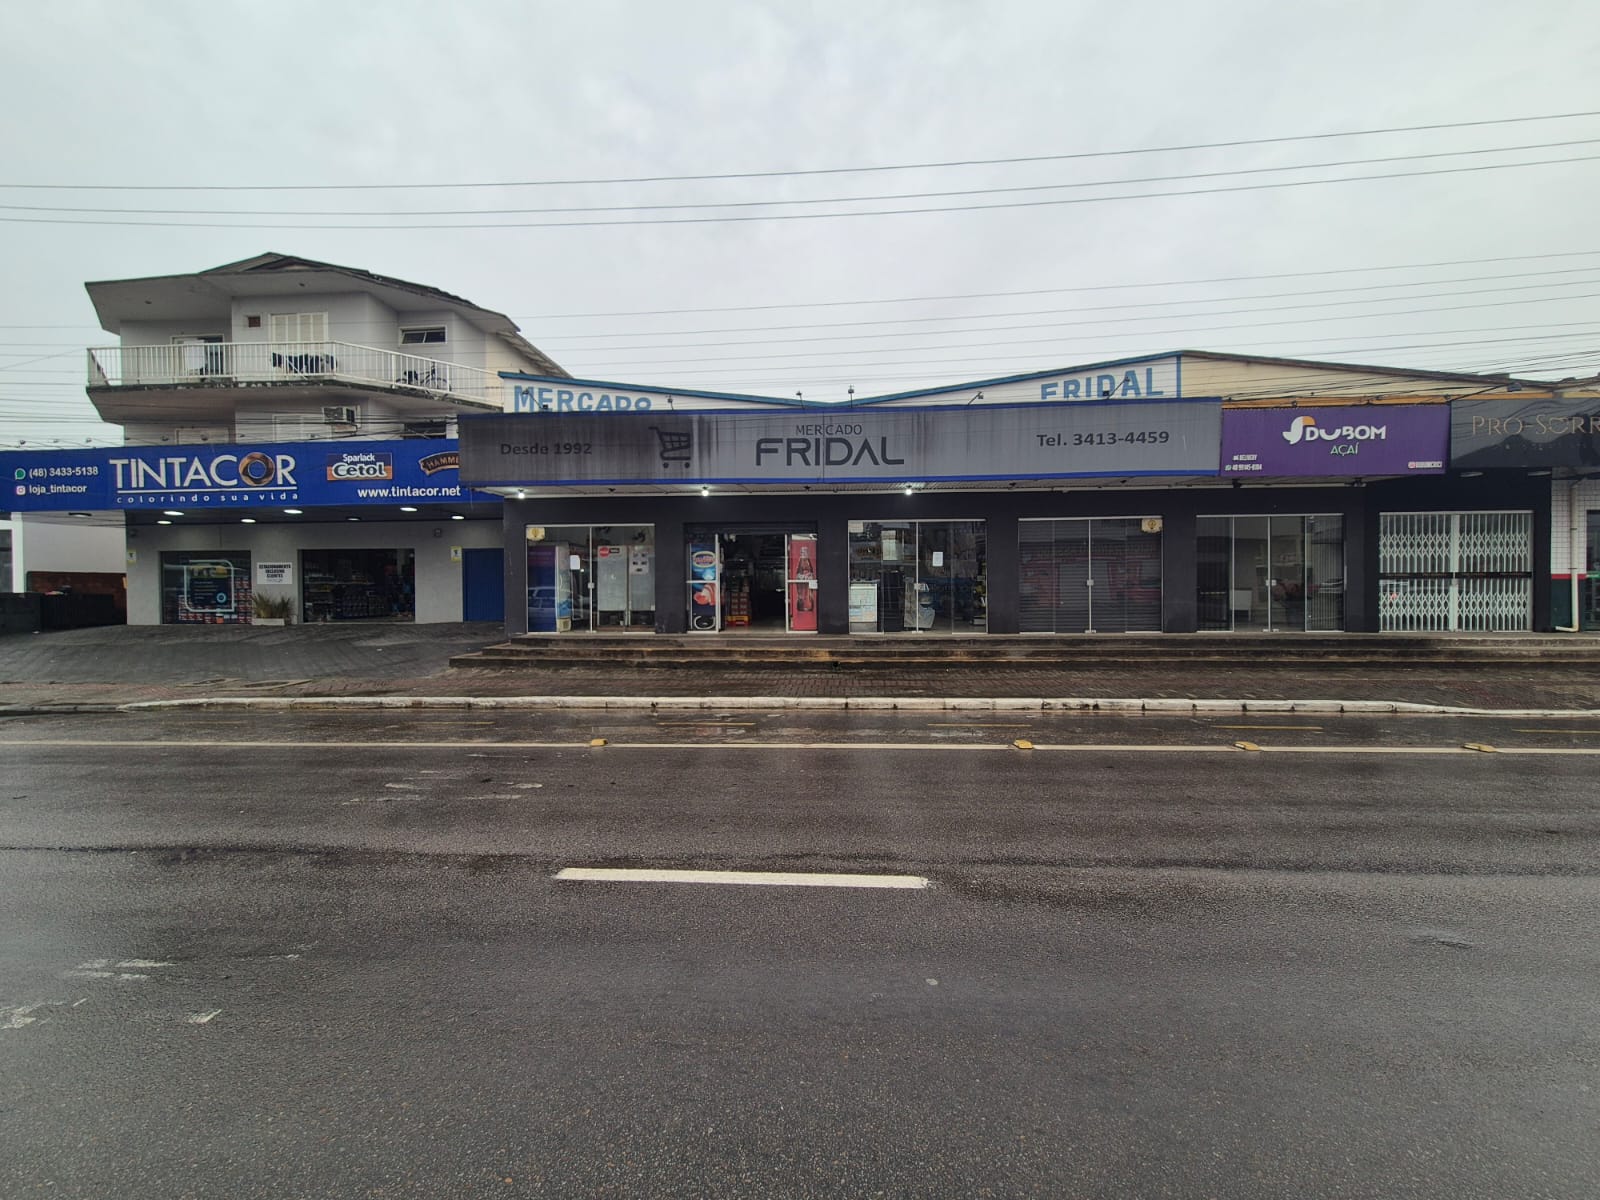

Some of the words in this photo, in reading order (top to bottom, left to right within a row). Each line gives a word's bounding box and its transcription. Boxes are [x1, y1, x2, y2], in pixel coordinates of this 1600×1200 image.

[1040, 367, 1164, 400] FRIDAL
[513, 385, 652, 413] MERCADO
[796, 424, 863, 436] MERCADO
[1305, 425, 1387, 441] DUBOM
[1036, 434, 1068, 447] Tel.
[1072, 431, 1170, 446] 3413-4459
[500, 443, 549, 456] Desde
[553, 443, 593, 455] 1992
[755, 436, 905, 466] FRIDAL
[1330, 442, 1360, 457] AÇAÍ
[342, 453, 376, 464] Sparlack
[29, 468, 47, 479] (48)
[49, 466, 99, 477] 3433-5138
[108, 451, 297, 488] TINTACOR
[332, 462, 387, 478] Cetol
[29, 484, 87, 496] loja_tintacor
[357, 485, 461, 498] www.tintacor.net
[116, 494, 210, 504] colorindo
[259, 492, 298, 501] vida
